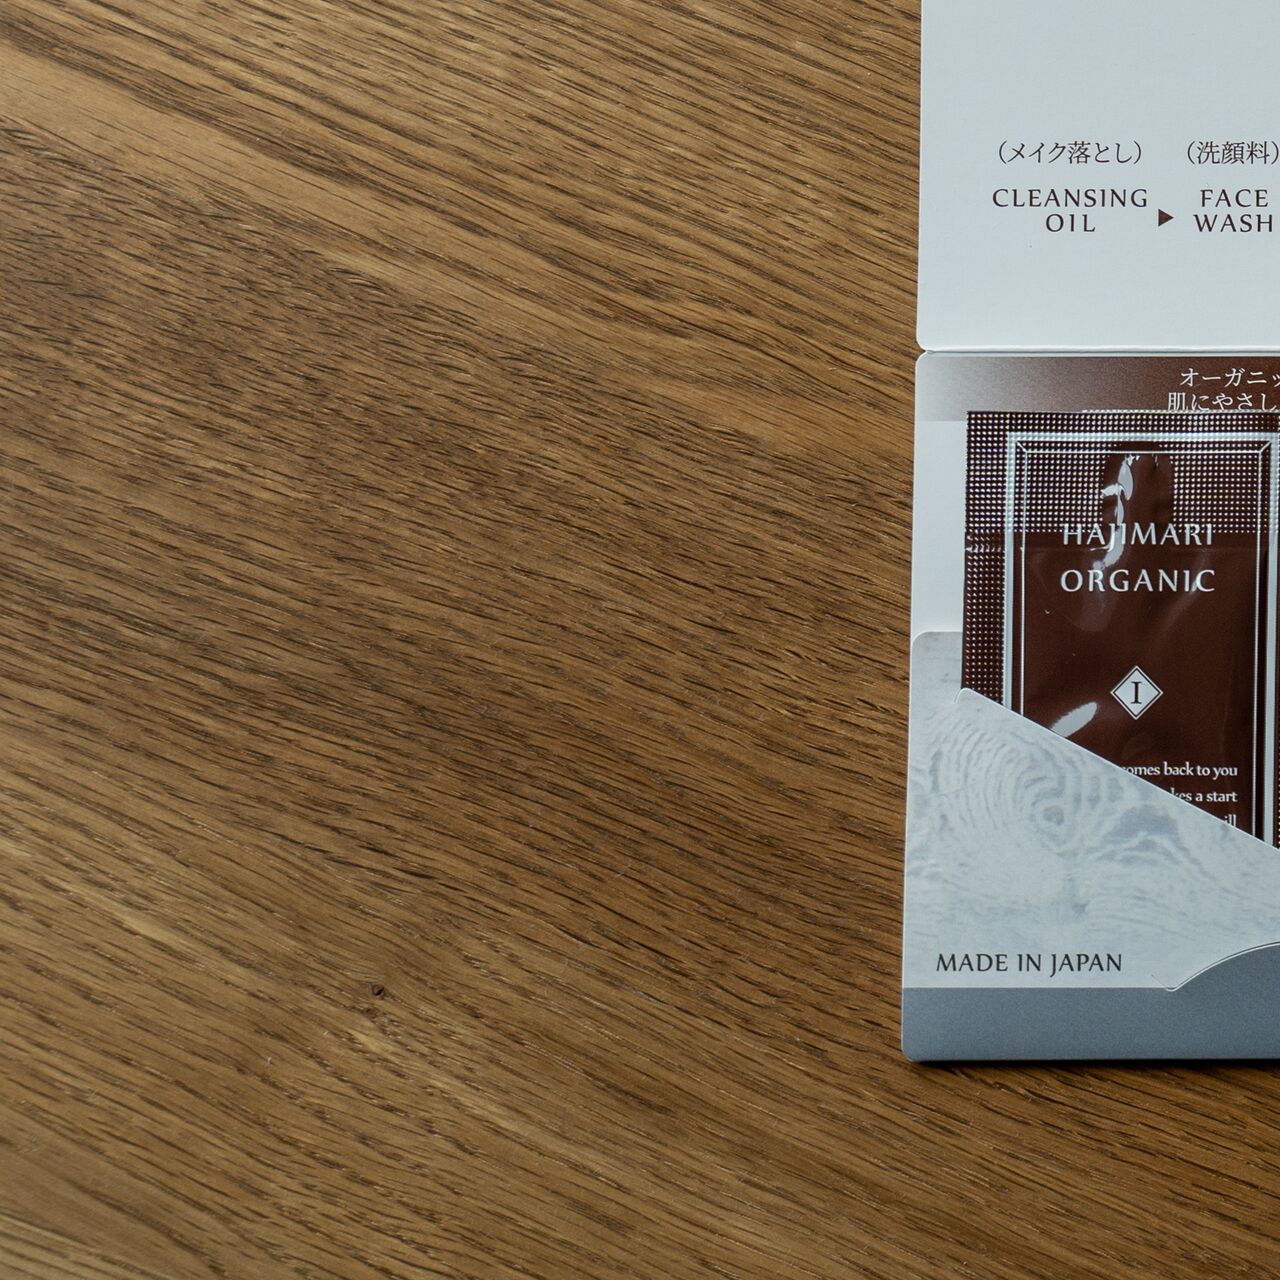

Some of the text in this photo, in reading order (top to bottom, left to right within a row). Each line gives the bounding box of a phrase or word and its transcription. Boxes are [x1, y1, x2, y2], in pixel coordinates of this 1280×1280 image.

[992, 188, 1147, 208] CLEANSING
[1200, 188, 1269, 208] FACE
[1045, 213, 1096, 233] OIL
[1192, 213, 1273, 233] WASH
[1062, 522, 1215, 552] HAJIMARI
[1058, 568, 1217, 594] ORGANIC
[1163, 760, 1194, 776] back
[1196, 766, 1211, 776] to
[1212, 766, 1237, 780] you
[1195, 793, 1203, 803] a
[1206, 790, 1238, 802] start
[936, 953, 1122, 978] MADE IN JAPAN
